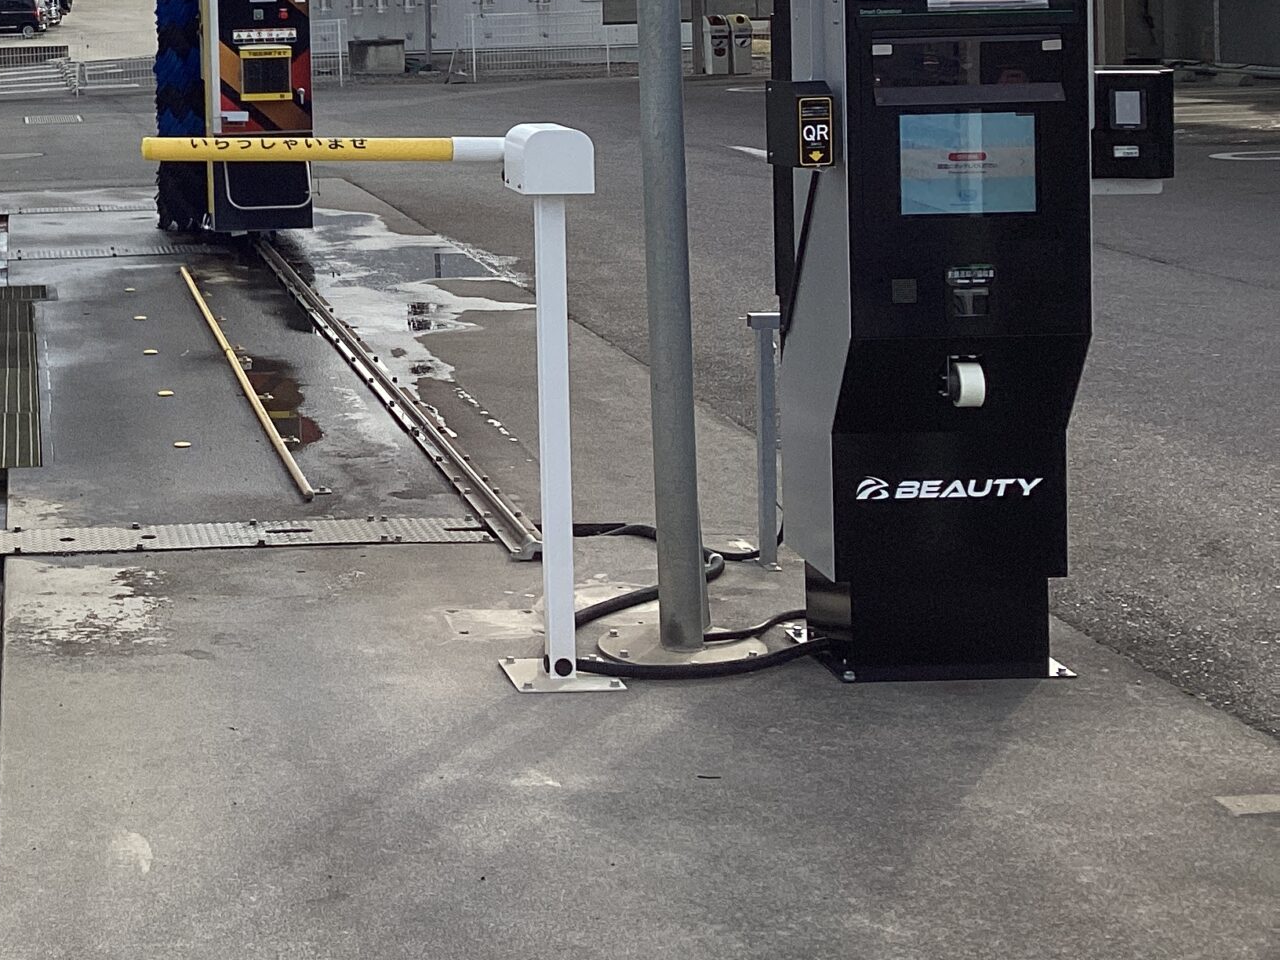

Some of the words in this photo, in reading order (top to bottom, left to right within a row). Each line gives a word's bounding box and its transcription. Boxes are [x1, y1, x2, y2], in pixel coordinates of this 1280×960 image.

[802, 124, 829, 141] QR
[189, 137, 368, 151] いらっしゃいませ
[894, 477, 1044, 499] BEAUTY
